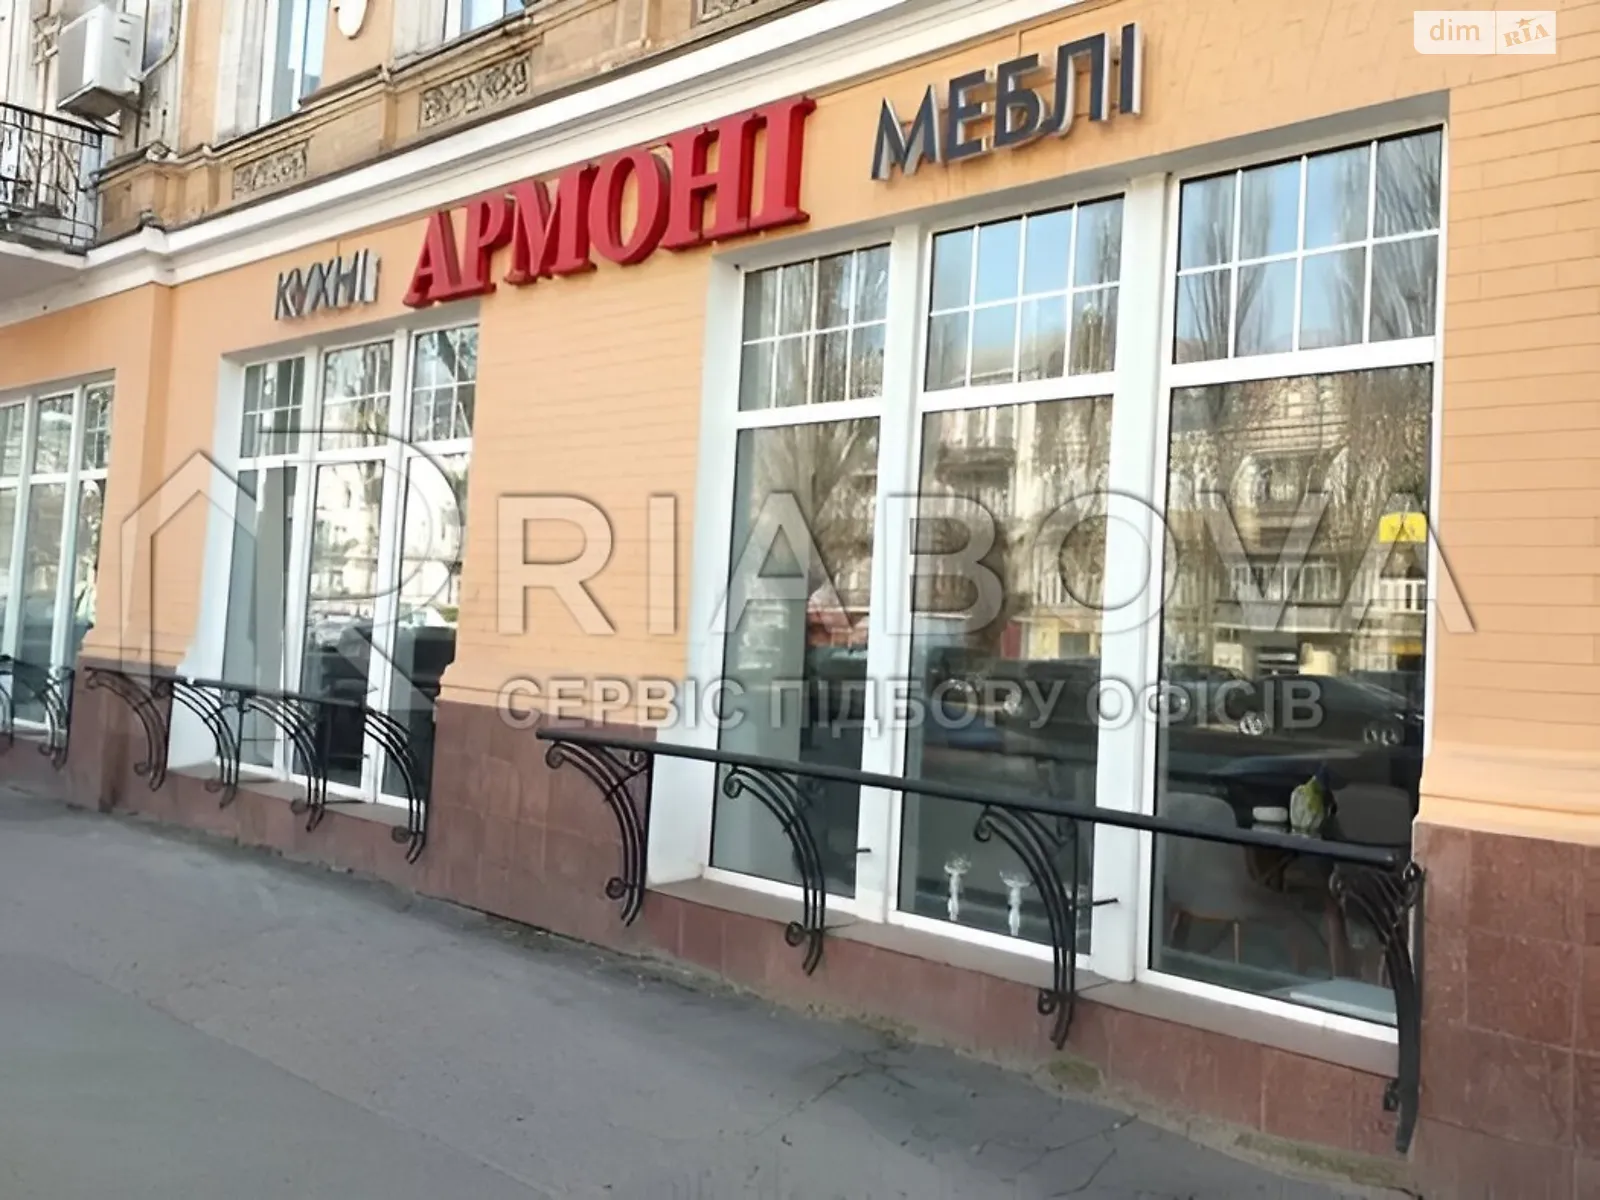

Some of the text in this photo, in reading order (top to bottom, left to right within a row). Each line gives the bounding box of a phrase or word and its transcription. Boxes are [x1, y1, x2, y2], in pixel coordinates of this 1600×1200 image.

[275, 23, 1144, 320] КУХНІ АРМОНІ МЕБЛІ
